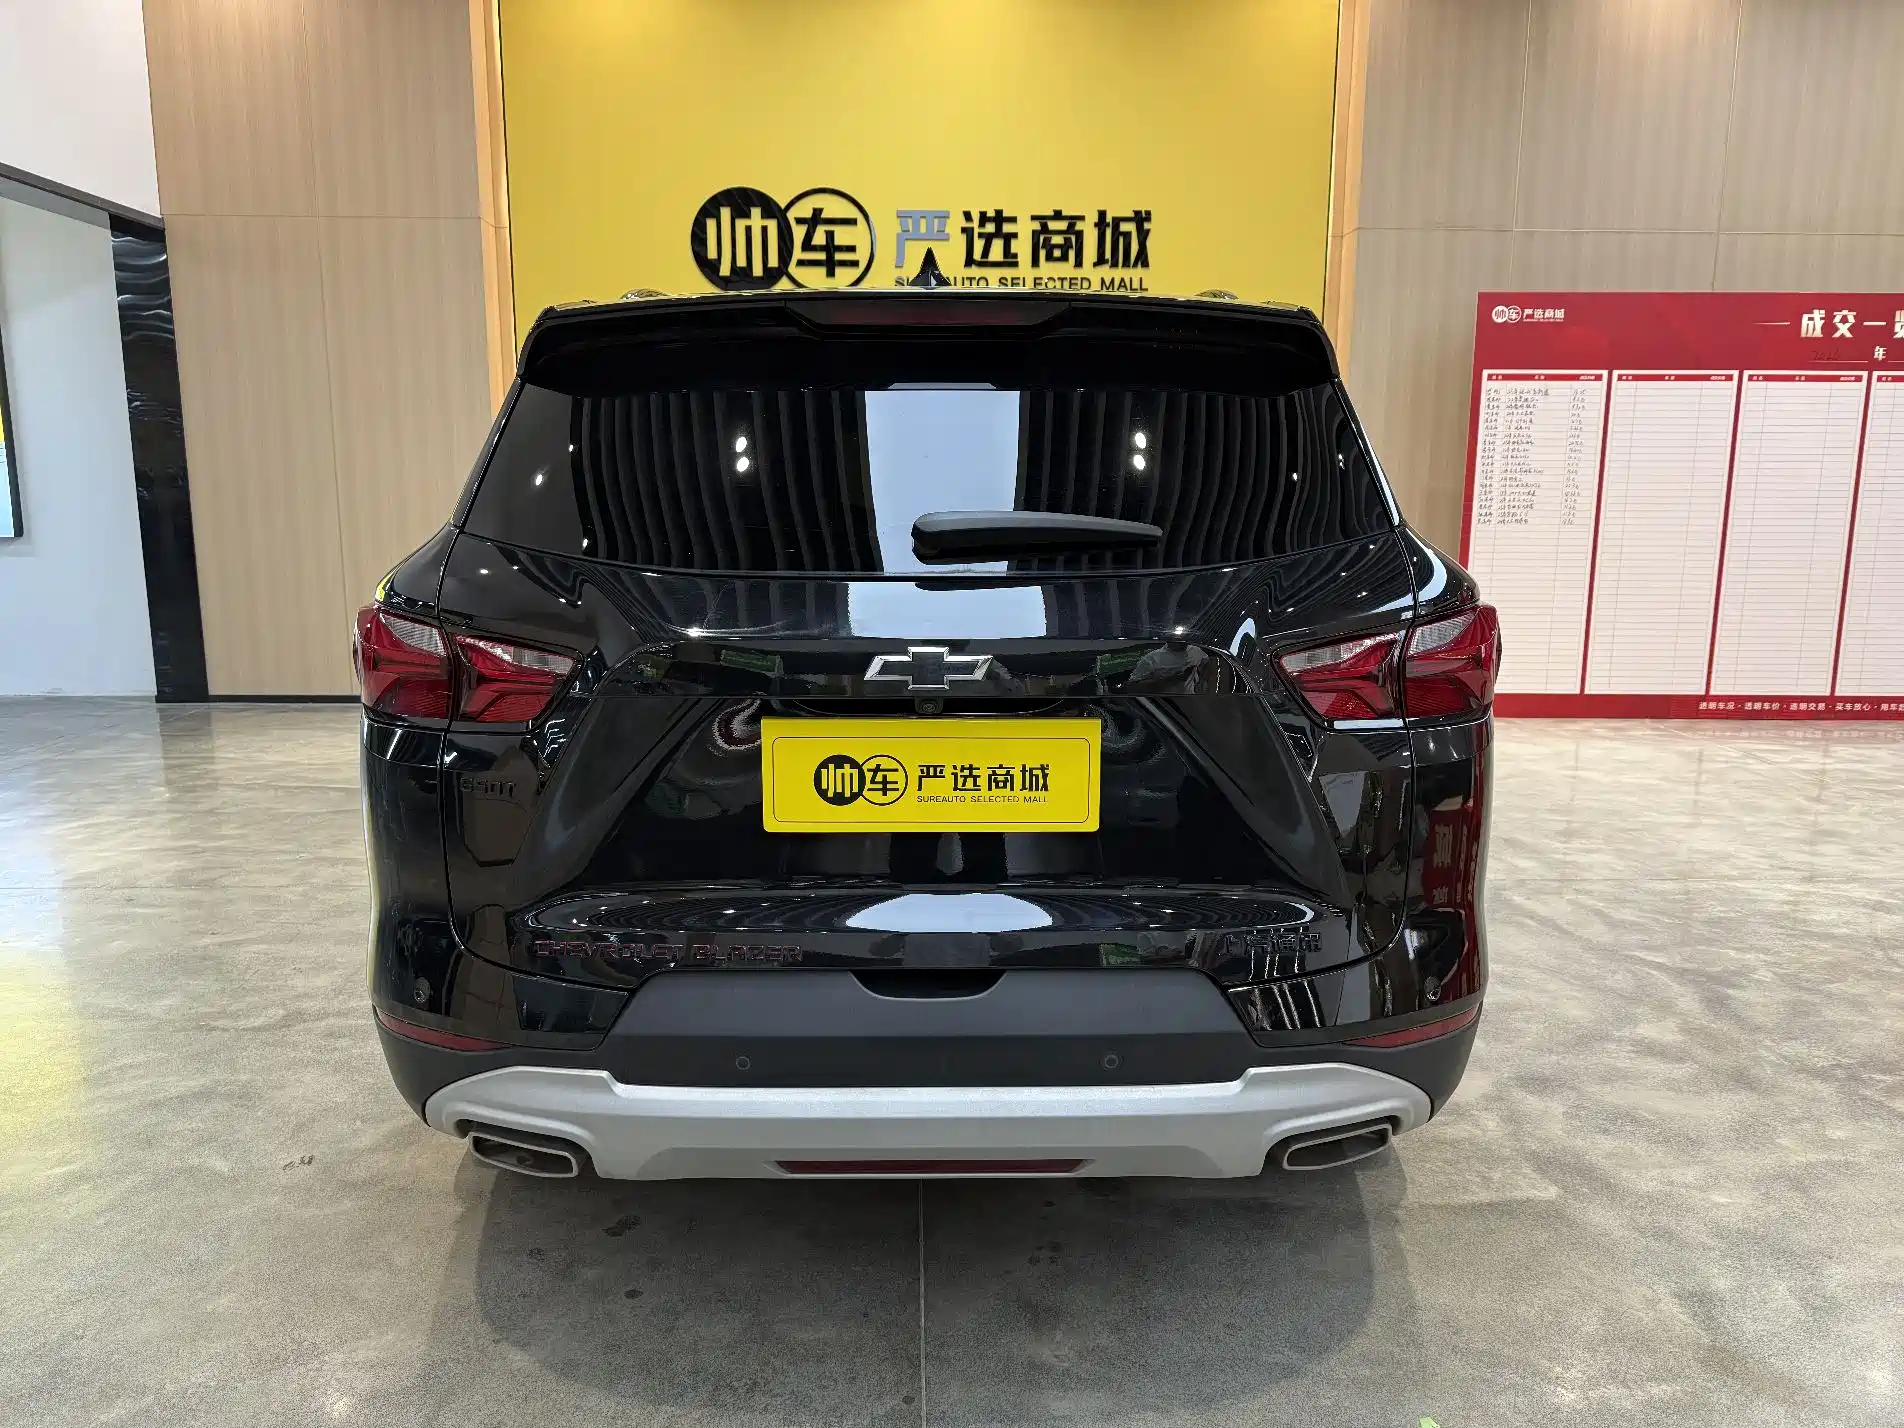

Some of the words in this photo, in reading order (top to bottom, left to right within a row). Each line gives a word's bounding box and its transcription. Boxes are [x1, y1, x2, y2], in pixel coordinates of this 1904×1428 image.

[702, 202, 863, 281] 帅车
[894, 209, 1153, 269] 严选商城
[997, 276, 1092, 290] SELECTED
[1100, 276, 1149, 291] MALL
[1873, 345, 1887, 361] 年
[819, 761, 902, 800] 帅车
[916, 763, 1050, 793] 严选商城
[916, 795, 967, 803] SUREAUTO
[970, 795, 1020, 803] SELECTED
[1023, 795, 1048, 803] MALL
[692, 943, 803, 961] BLAZER
